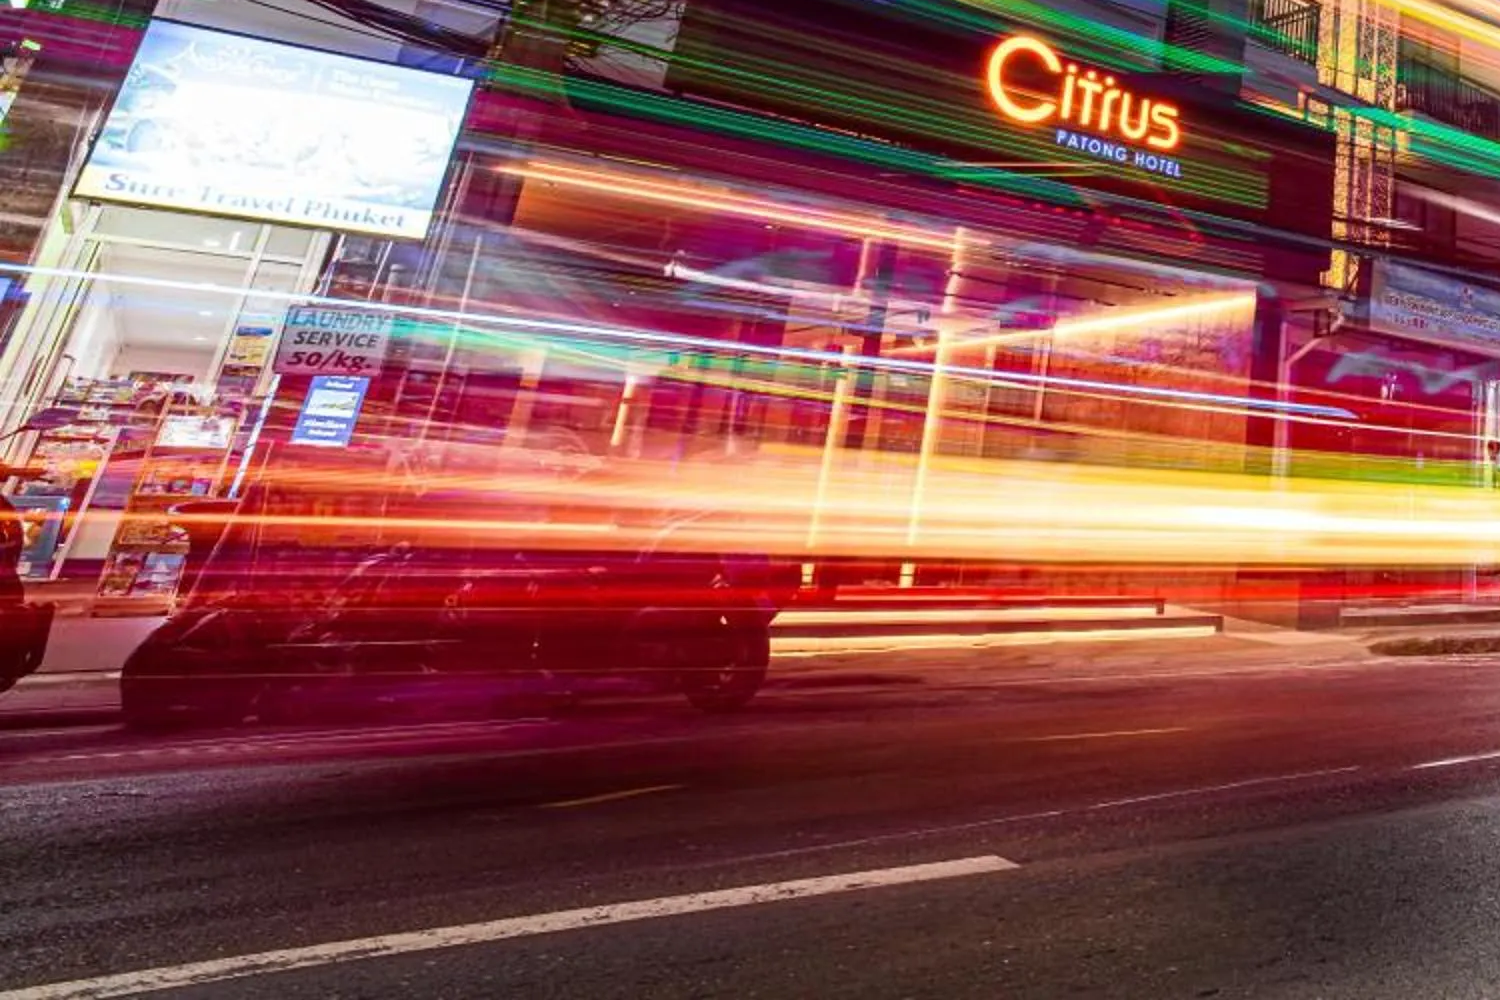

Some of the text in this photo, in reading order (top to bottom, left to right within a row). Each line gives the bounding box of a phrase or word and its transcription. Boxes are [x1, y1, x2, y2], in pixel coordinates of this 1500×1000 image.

[987, 35, 1180, 150] Citrus
[1055, 129, 1183, 178] PATONG HOTEL
[198, 184, 294, 215] Travel
[303, 196, 404, 228] Phuket
[290, 308, 385, 331] LAUNDRY
[293, 330, 381, 348] SERVICE
[285, 349, 374, 372] 50/kg.
